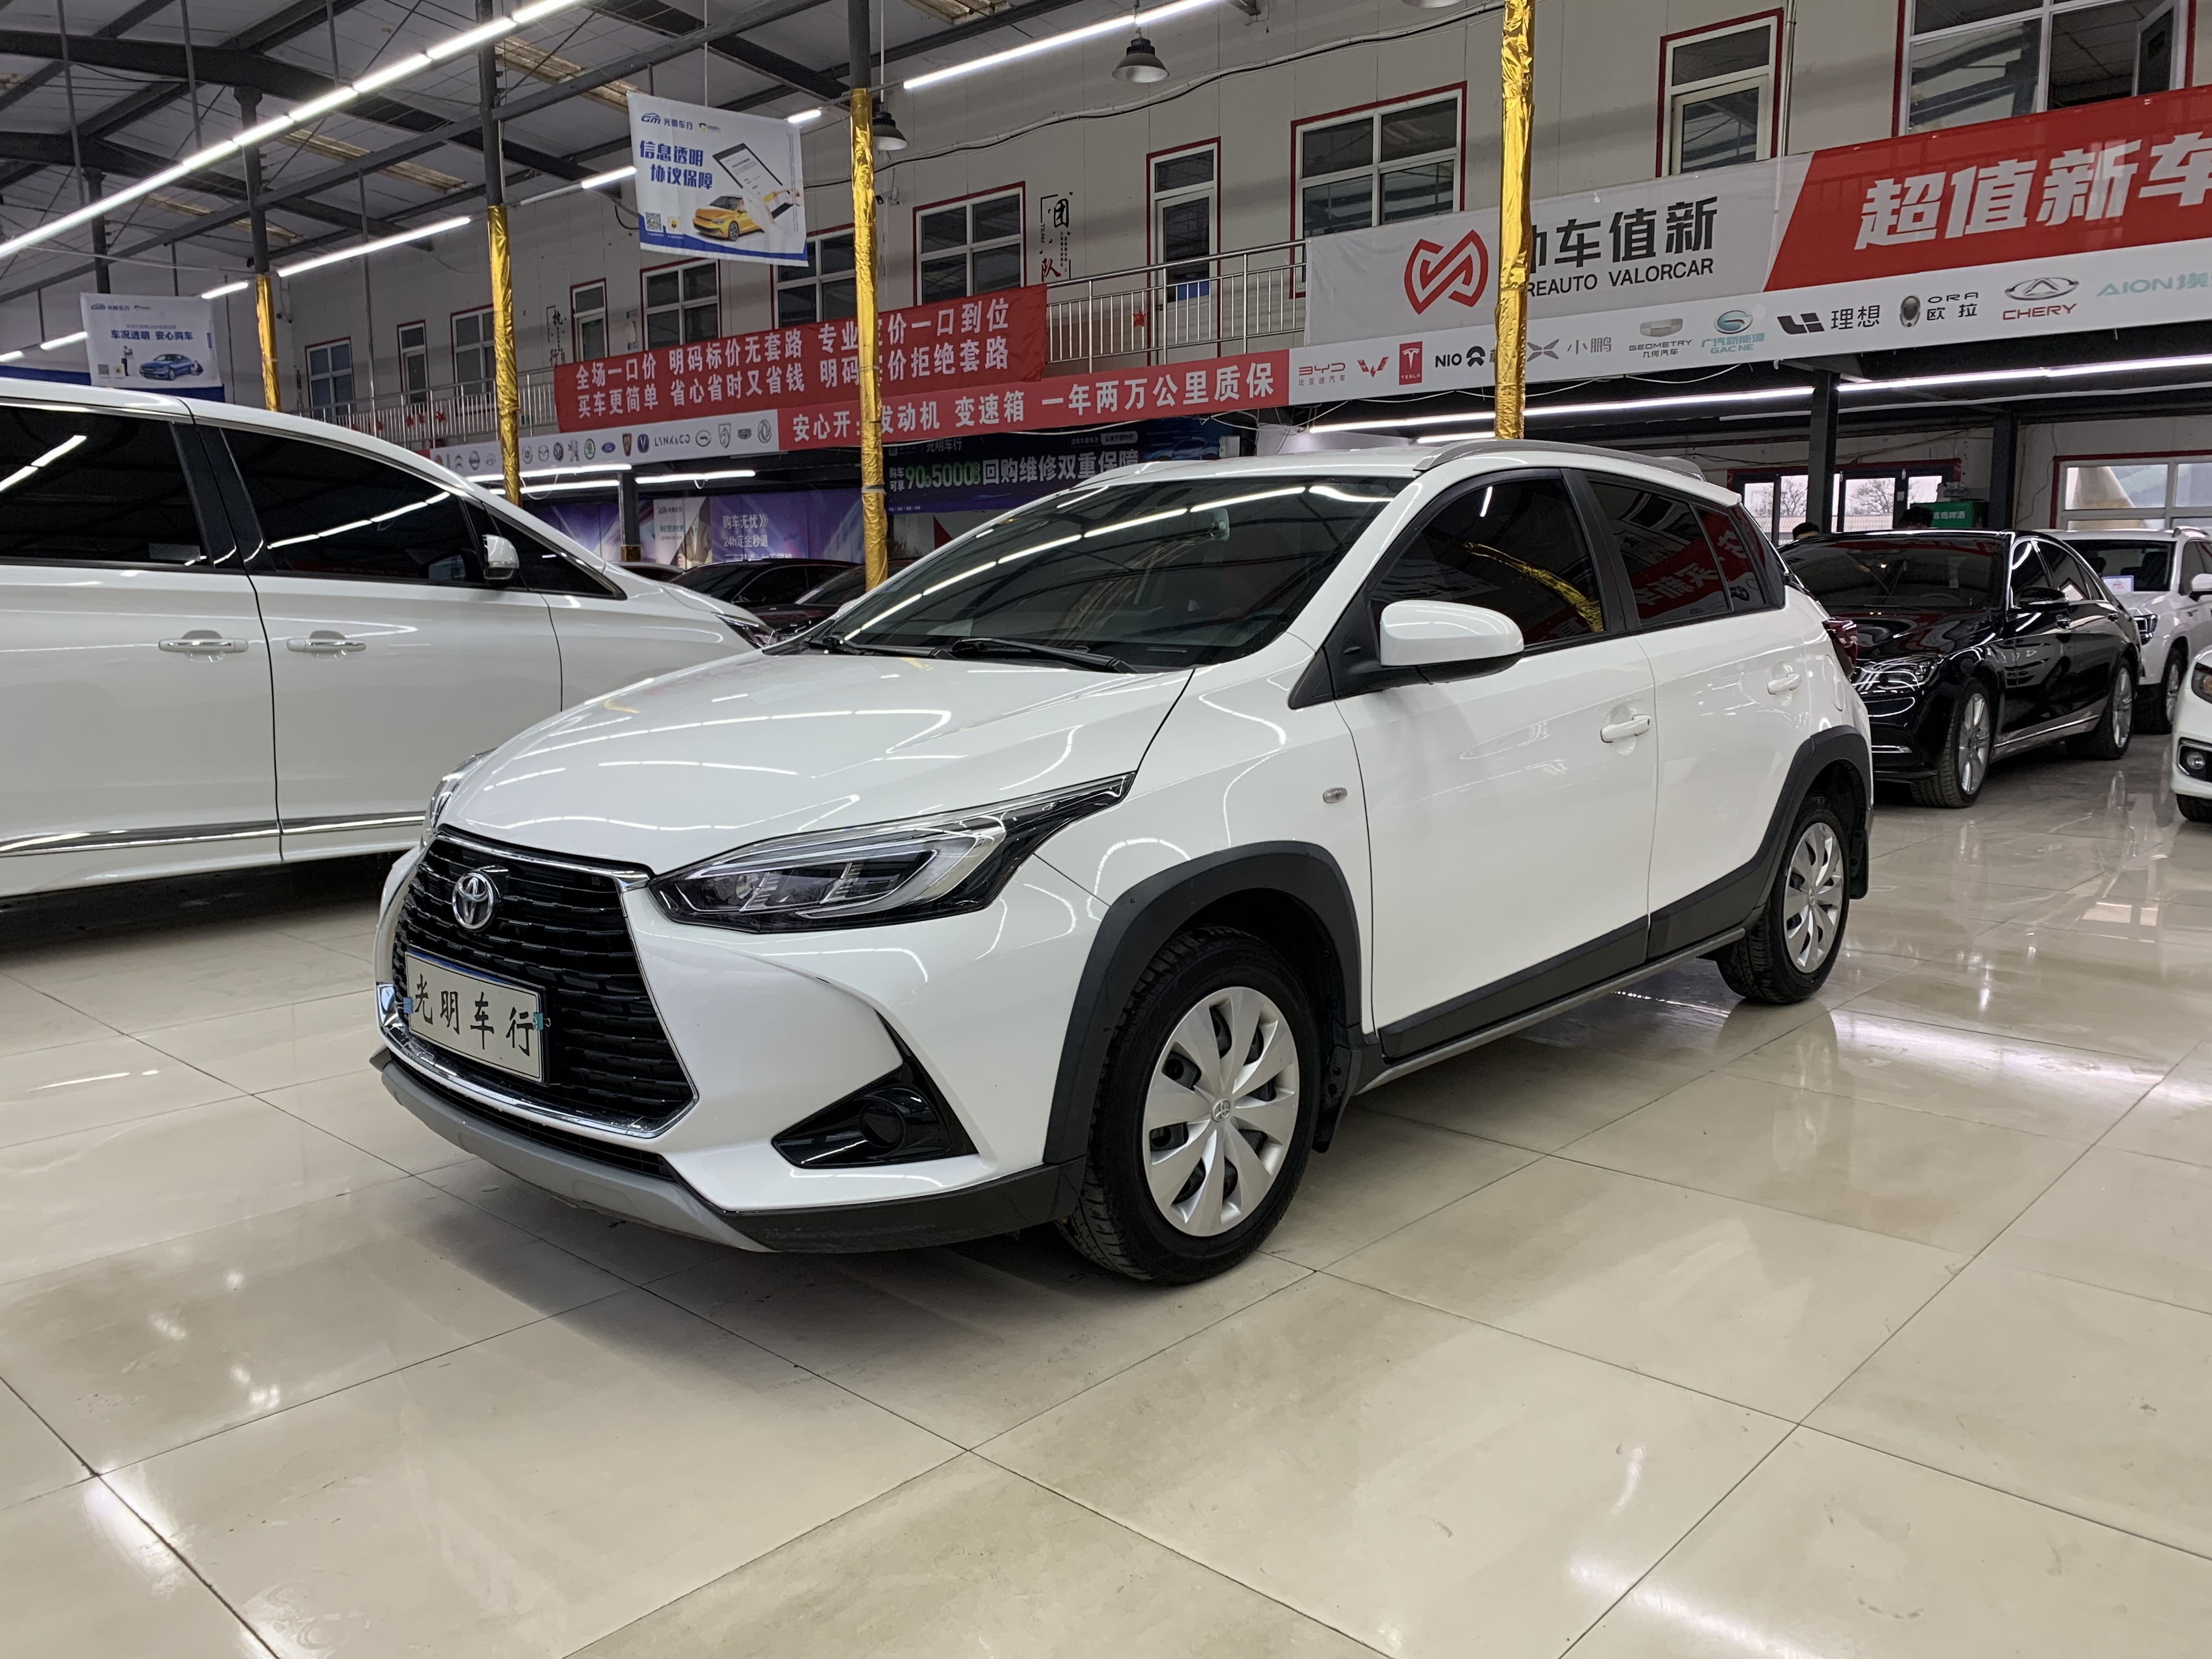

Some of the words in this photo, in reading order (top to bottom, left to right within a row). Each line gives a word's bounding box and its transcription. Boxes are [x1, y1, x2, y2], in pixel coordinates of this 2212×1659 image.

[640, 140, 703, 167] 信息透明
[651, 164, 713, 189] 协议保障
[1854, 131, 2212, 250] 超值新车
[1609, 257, 1714, 287] VALORCAR
[2096, 277, 2173, 296] AION
[2176, 272, 2212, 290] 埃
[1928, 291, 1979, 303] ORA
[1830, 304, 1881, 330] 理想
[1927, 303, 1977, 321] 欧拉
[2002, 303, 2078, 320] CHERY
[111, 330, 150, 340] 车况透明
[155, 331, 193, 341] 安心购车
[576, 353, 656, 390] 全场一口价
[669, 329, 803, 375] 明码标价无套路
[818, 297, 1009, 353] 专业价一口到位
[1701, 333, 1765, 348] 广汽新能源
[1567, 336, 1612, 355] 小鹏
[1629, 340, 1692, 351] GEOMETRY
[1643, 348, 1678, 358] 几何汽车
[1299, 363, 1346, 376] BYD
[1435, 353, 1462, 368] NIO
[578, 383, 658, 419] 买车更简单
[671, 363, 805, 407] 省心省时又省钱
[820, 336, 1008, 388] 明码价拒绝套路
[1298, 375, 1346, 386] 比亚迪汽车
[955, 390, 1025, 428] 变速箱
[1042, 362, 1274, 416] 一年两万公里质保
[926, 438, 962, 453] 光明车行
[1933, 511, 1965, 520] 青岛啤酒
[414, 973, 534, 1057] 光明车行
